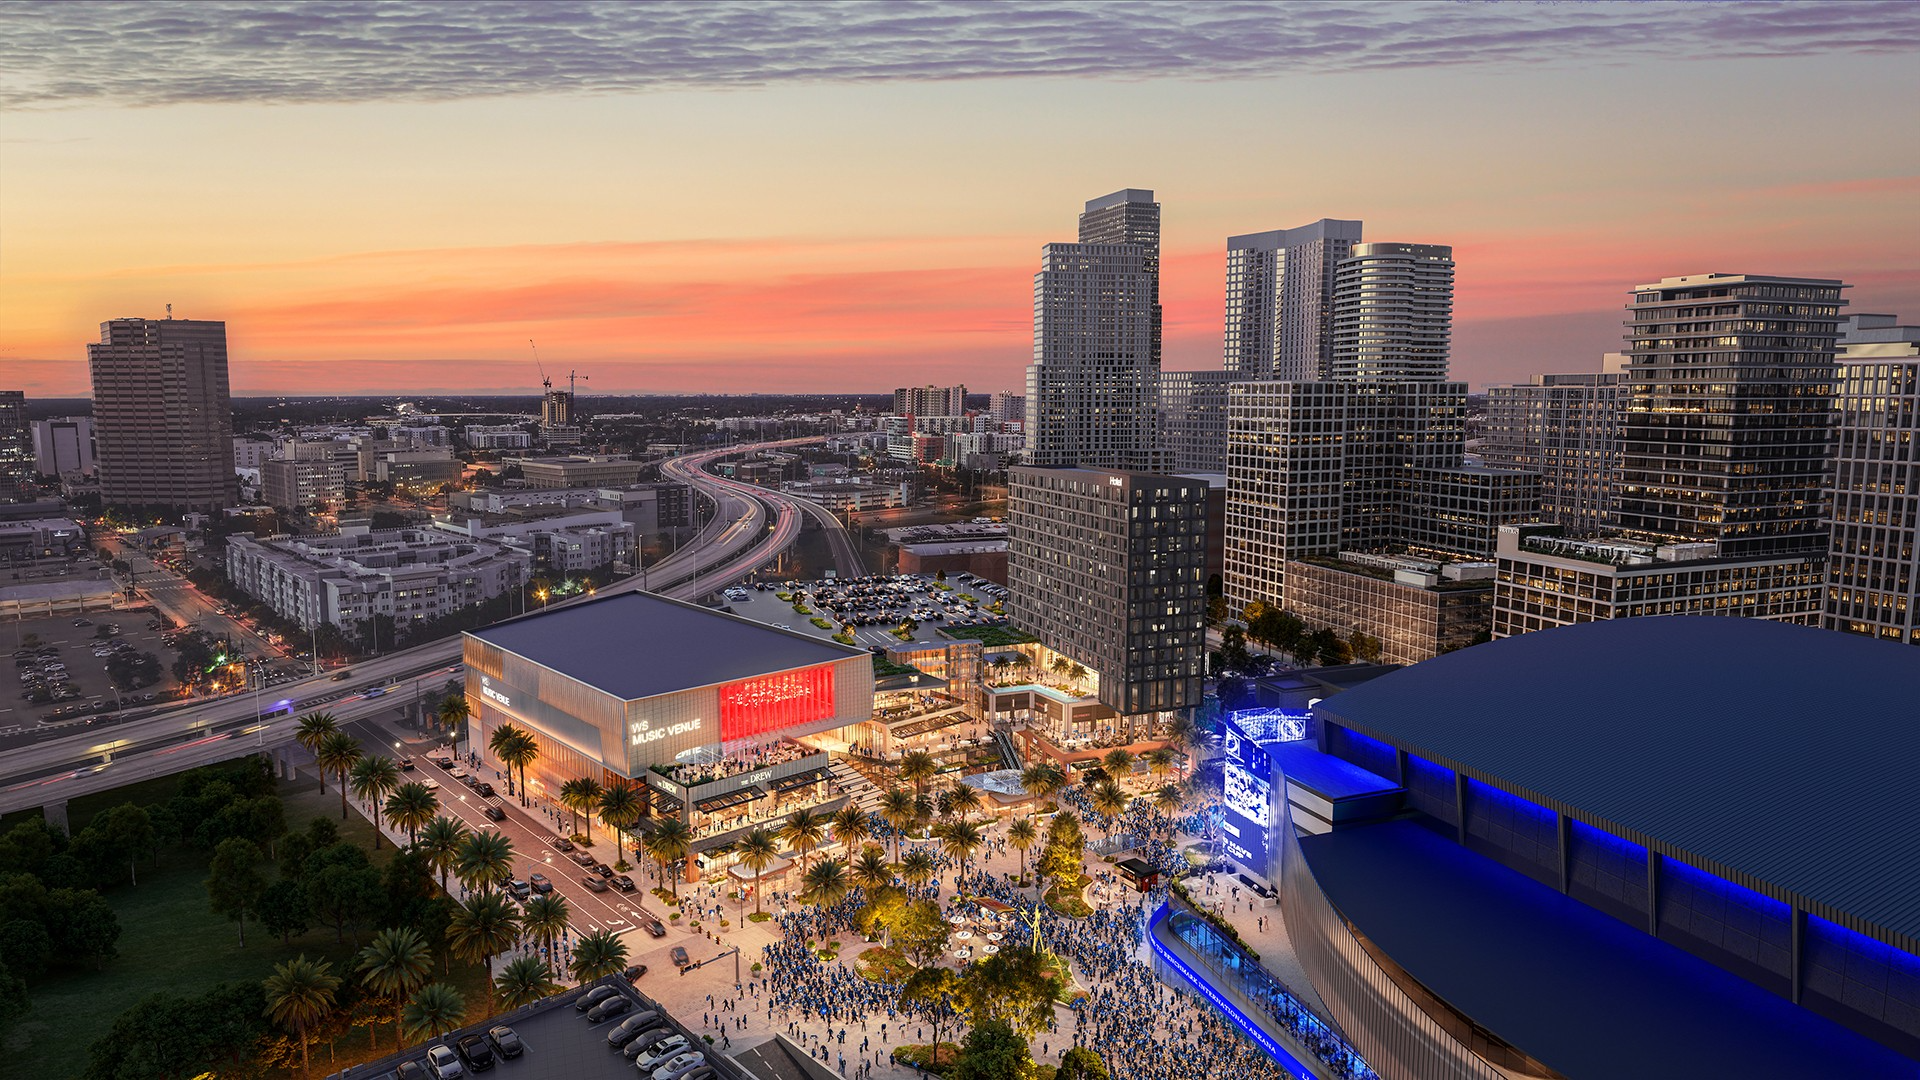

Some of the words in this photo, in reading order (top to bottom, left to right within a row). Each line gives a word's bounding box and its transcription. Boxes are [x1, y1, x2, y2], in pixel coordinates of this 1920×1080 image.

[1110, 476, 1122, 486] Hotel
[631, 720, 649, 734] WS
[632, 727, 666, 746] MUSIC
[667, 718, 701, 737] VENUE
[750, 770, 773, 783] DREW
[762, 817, 788, 831] REVIVAL
